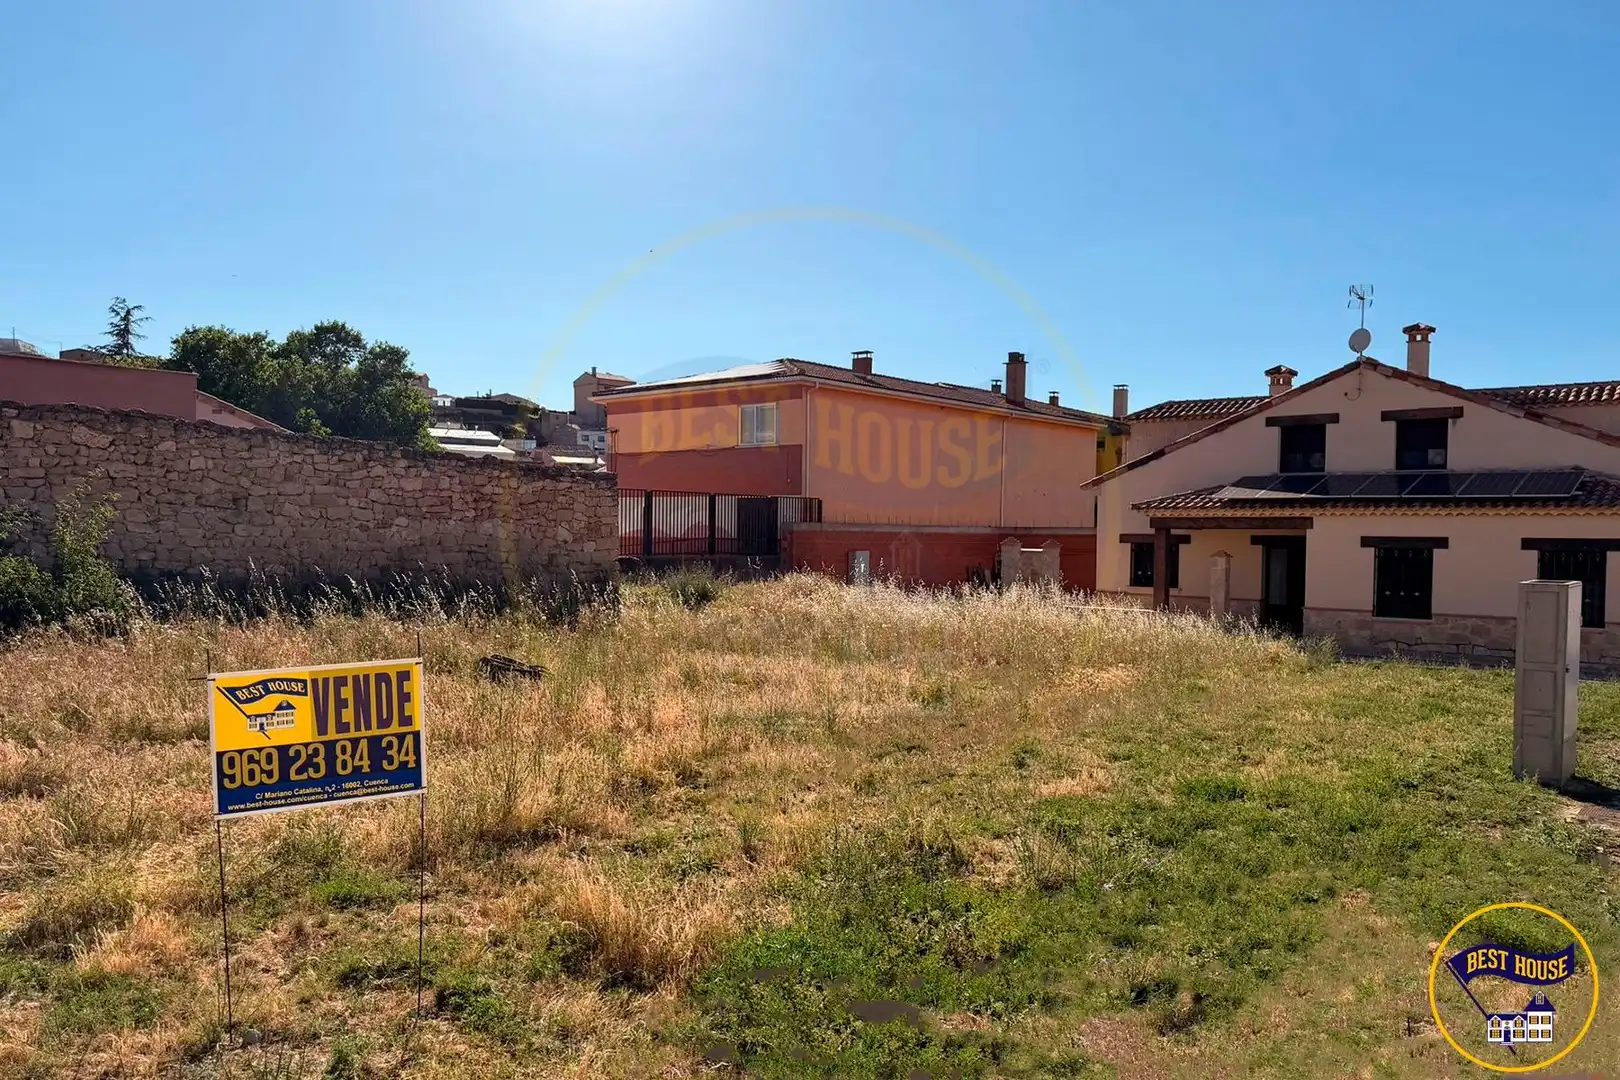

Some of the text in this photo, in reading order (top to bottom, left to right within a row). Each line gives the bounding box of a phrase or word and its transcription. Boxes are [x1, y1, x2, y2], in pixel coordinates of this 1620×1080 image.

[235, 680, 305, 701] BEST HOUSE
[311, 670, 413, 737] VENDE
[222, 734, 416, 789] 969 23 84 34
[227, 792, 328, 811] www.best-house.com/cuenca
[333, 782, 414, 798] cuenca@best-house.com
[255, 792, 263, 800] C/
[264, 789, 293, 799] Mariano
[363, 778, 389, 787] Cuenca
